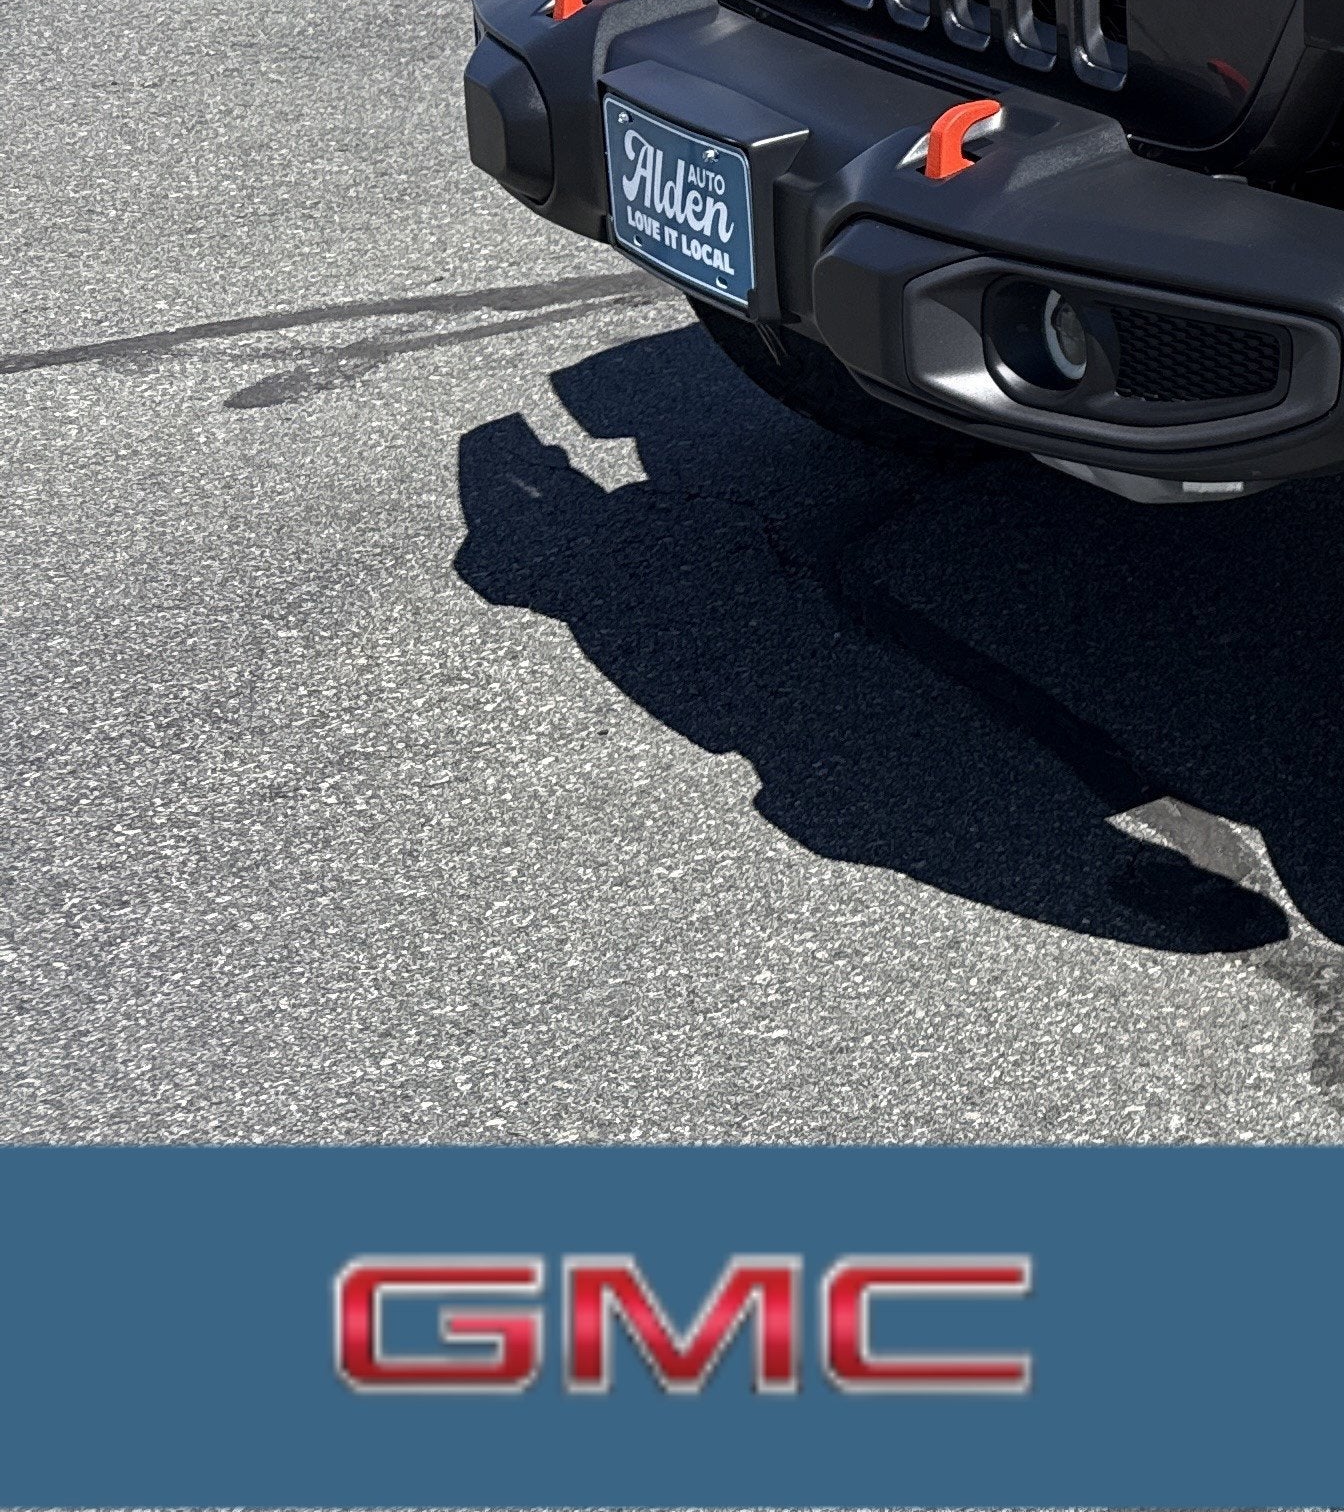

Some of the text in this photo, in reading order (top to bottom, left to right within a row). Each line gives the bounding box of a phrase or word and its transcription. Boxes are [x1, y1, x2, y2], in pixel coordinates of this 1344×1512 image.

[622, 129, 735, 244] Alden
[687, 163, 726, 196] AUTO
[626, 205, 735, 276] LOVE IT LOCAL
